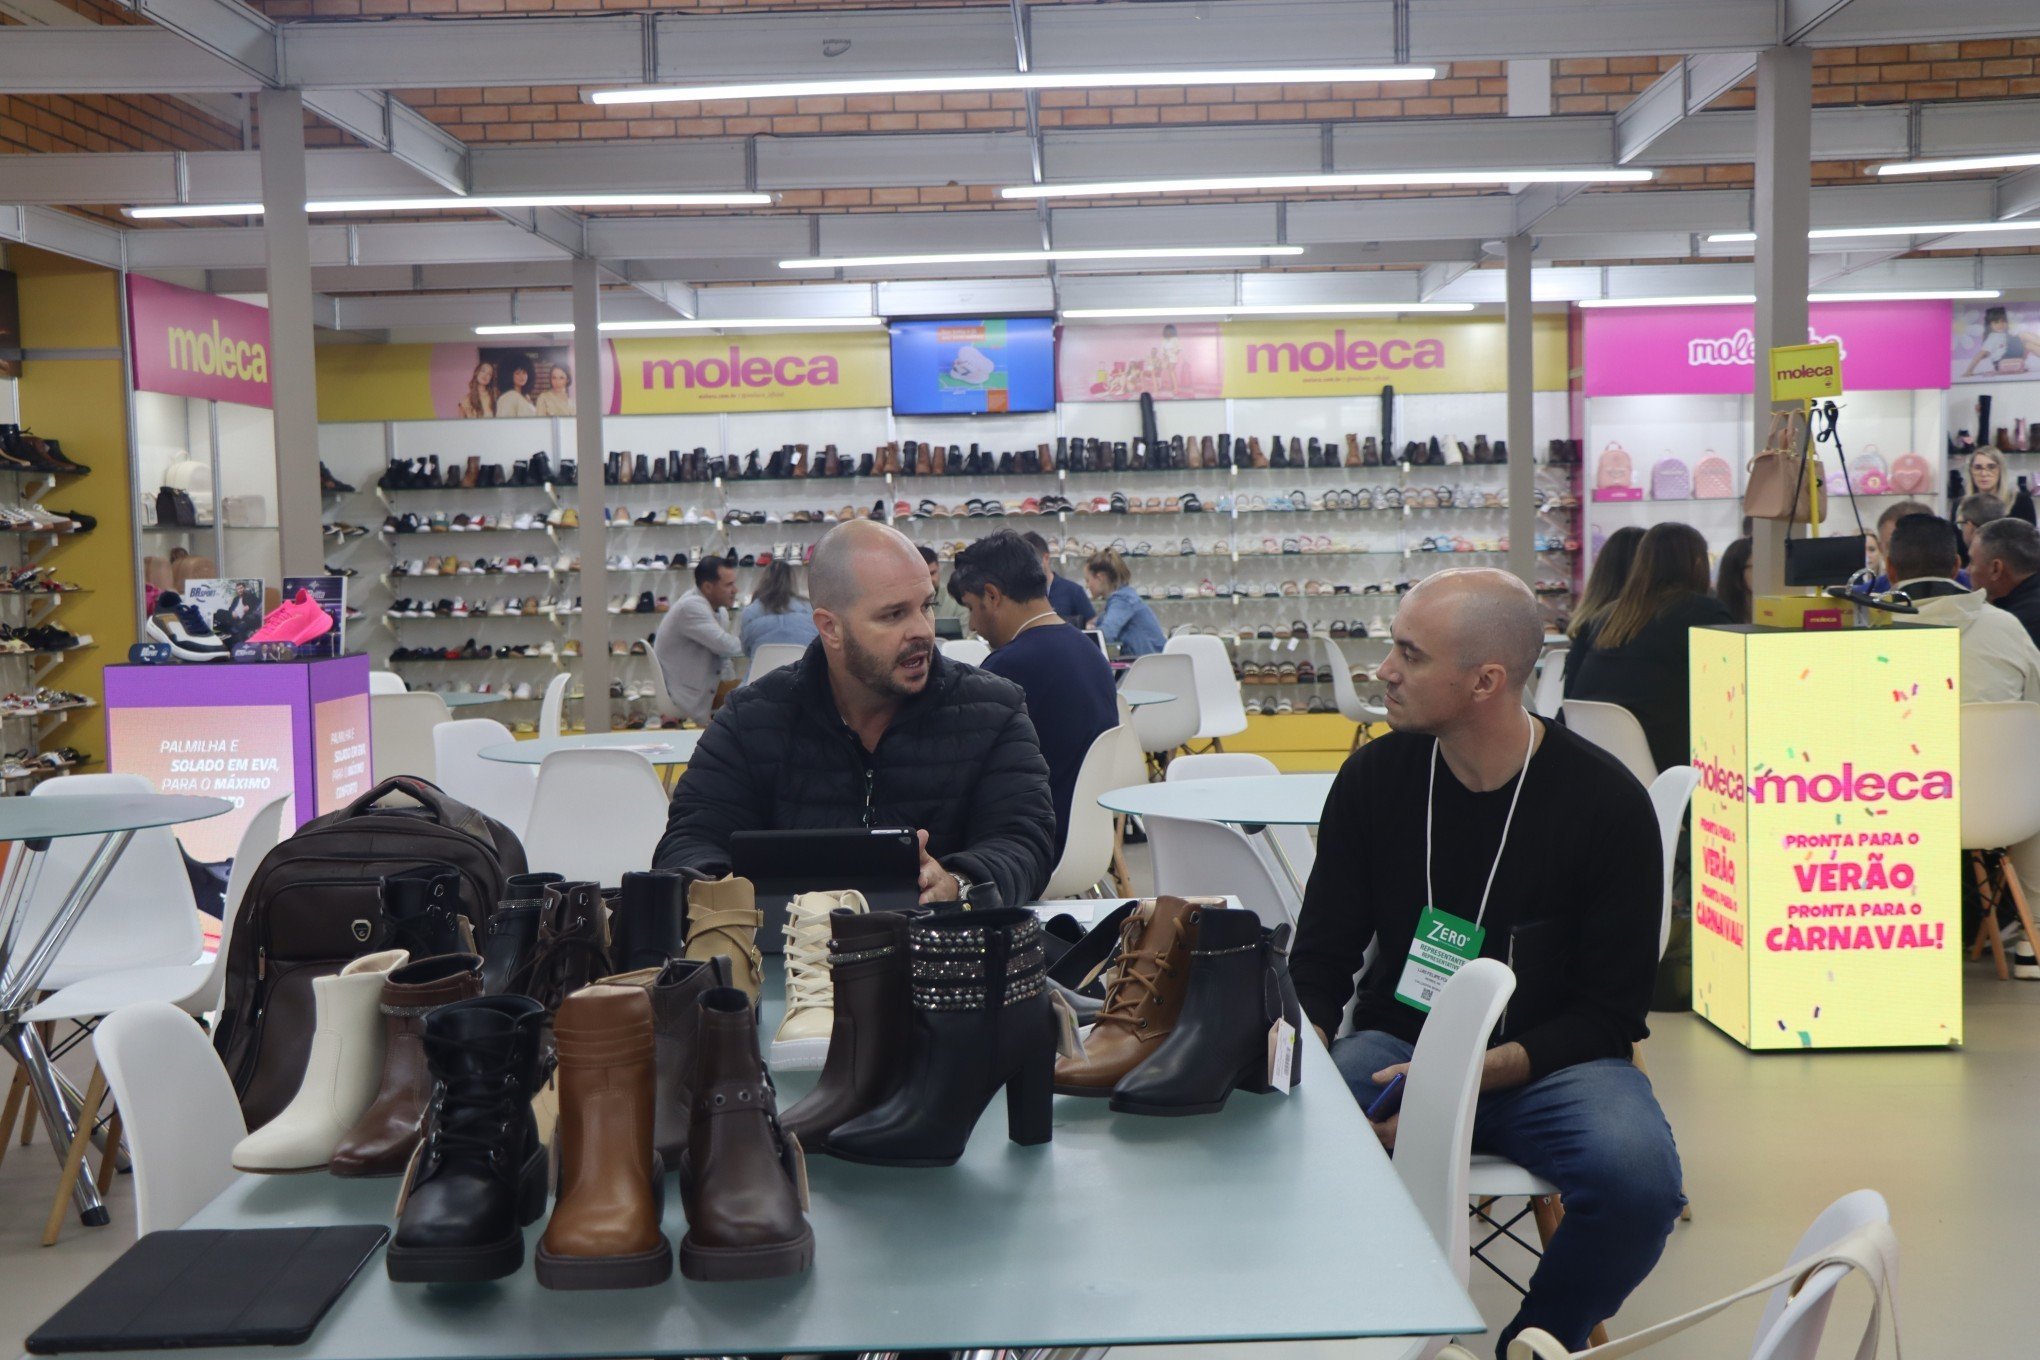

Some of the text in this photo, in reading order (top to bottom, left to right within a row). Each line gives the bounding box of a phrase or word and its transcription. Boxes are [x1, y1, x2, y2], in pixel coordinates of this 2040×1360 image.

[168, 319, 268, 383] moleca
[1246, 329, 1446, 374] moleca
[642, 345, 839, 390] moleca
[1777, 365, 1834, 380] moleca
[160, 739, 239, 753] PALMILHA E
[171, 758, 280, 773] SOLADO EM EVA,
[162, 774, 271, 791] PARA O MÁXIMO
[1754, 762, 1953, 804] moleca
[1786, 833, 1920, 848] PRONTA PARA O
[1793, 852, 1915, 893] VERÃO
[1788, 903, 1922, 918] PRONTA PARA O
[1766, 923, 1945, 952] CARNAVAL!
